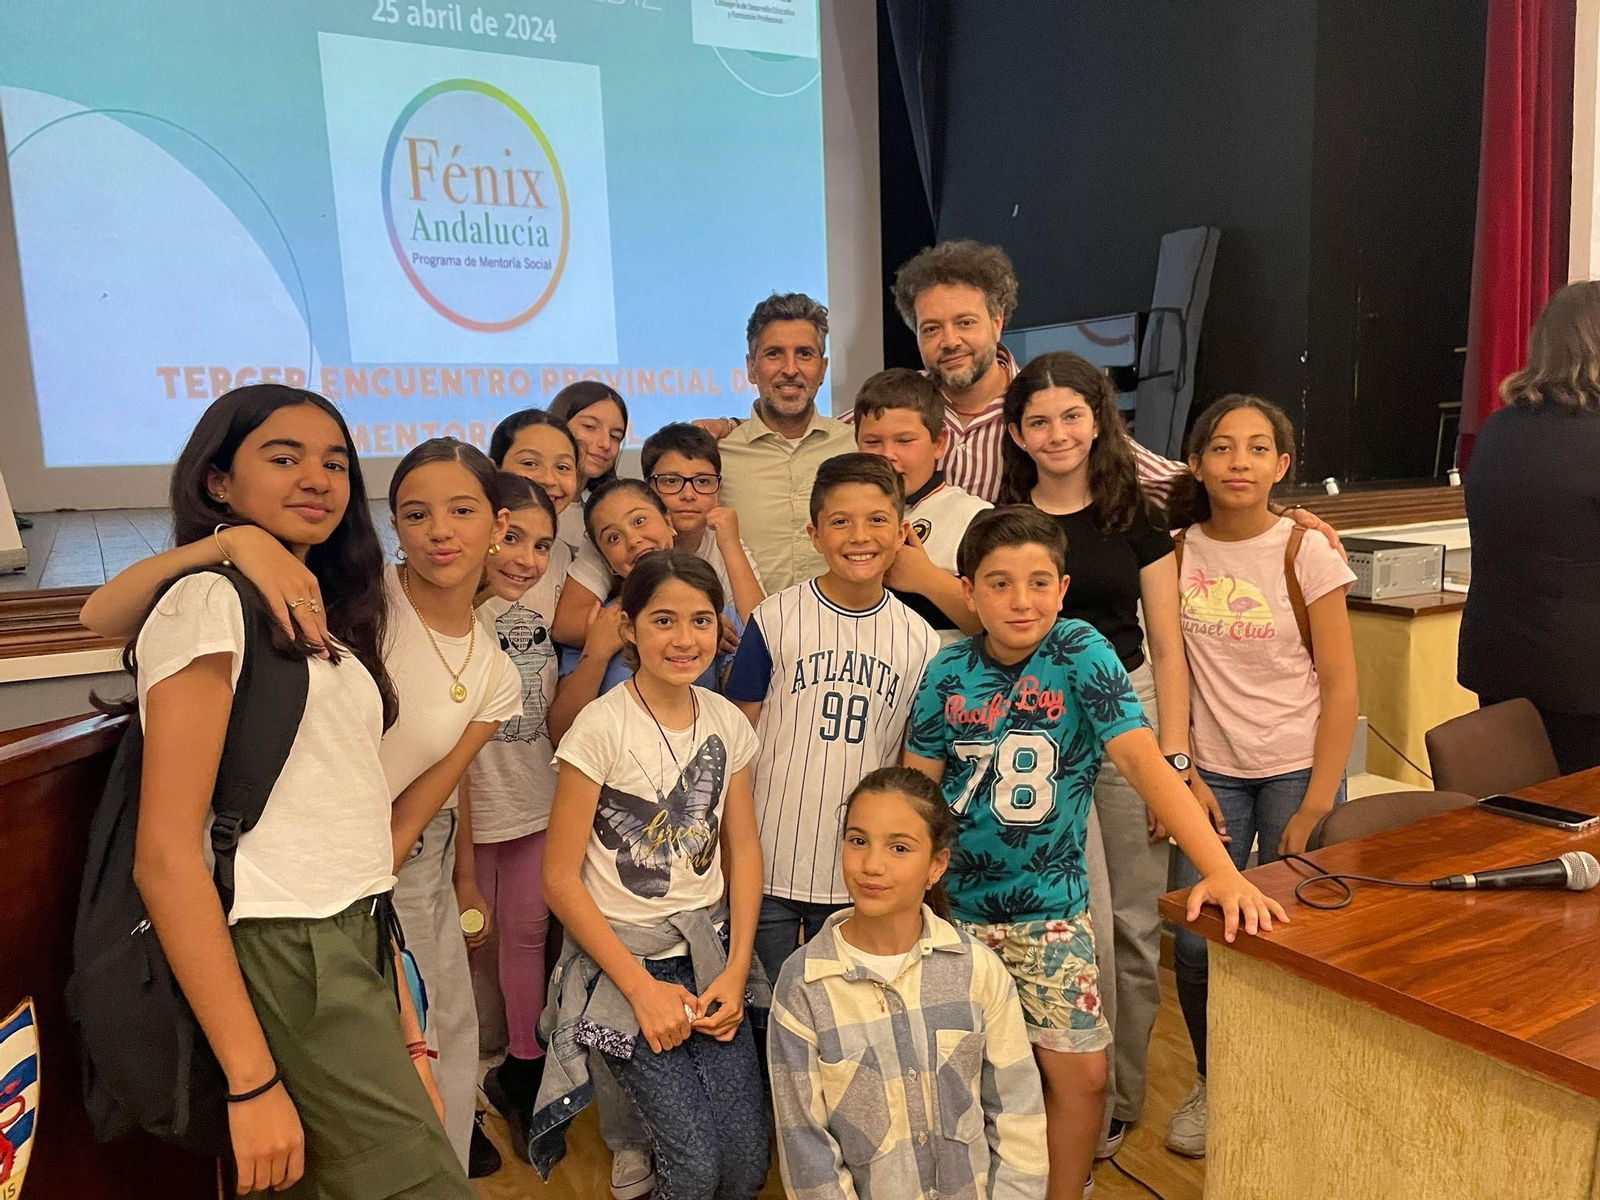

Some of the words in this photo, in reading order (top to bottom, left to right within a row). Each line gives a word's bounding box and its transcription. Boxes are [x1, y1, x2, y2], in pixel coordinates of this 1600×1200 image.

[372, 0, 400, 24] 25
[406, 0, 463, 32] abril
[469, 7, 498, 37] de
[504, 13, 557, 44] 2024
[403, 137, 550, 209] Fénix
[411, 208, 549, 247] Andalucía
[412, 252, 462, 268] Programa
[464, 255, 476, 267] de
[479, 256, 521, 269] Mentoría
[524, 257, 552, 270] Social
[320, 367, 531, 397] ENCUENTRO
[1183, 619, 1224, 636] unset
[1229, 621, 1275, 641] Club
[791, 650, 900, 708] ATLANTA
[1015, 675, 1067, 721] Bay
[820, 691, 869, 744] 98
[949, 729, 1060, 826] 78
